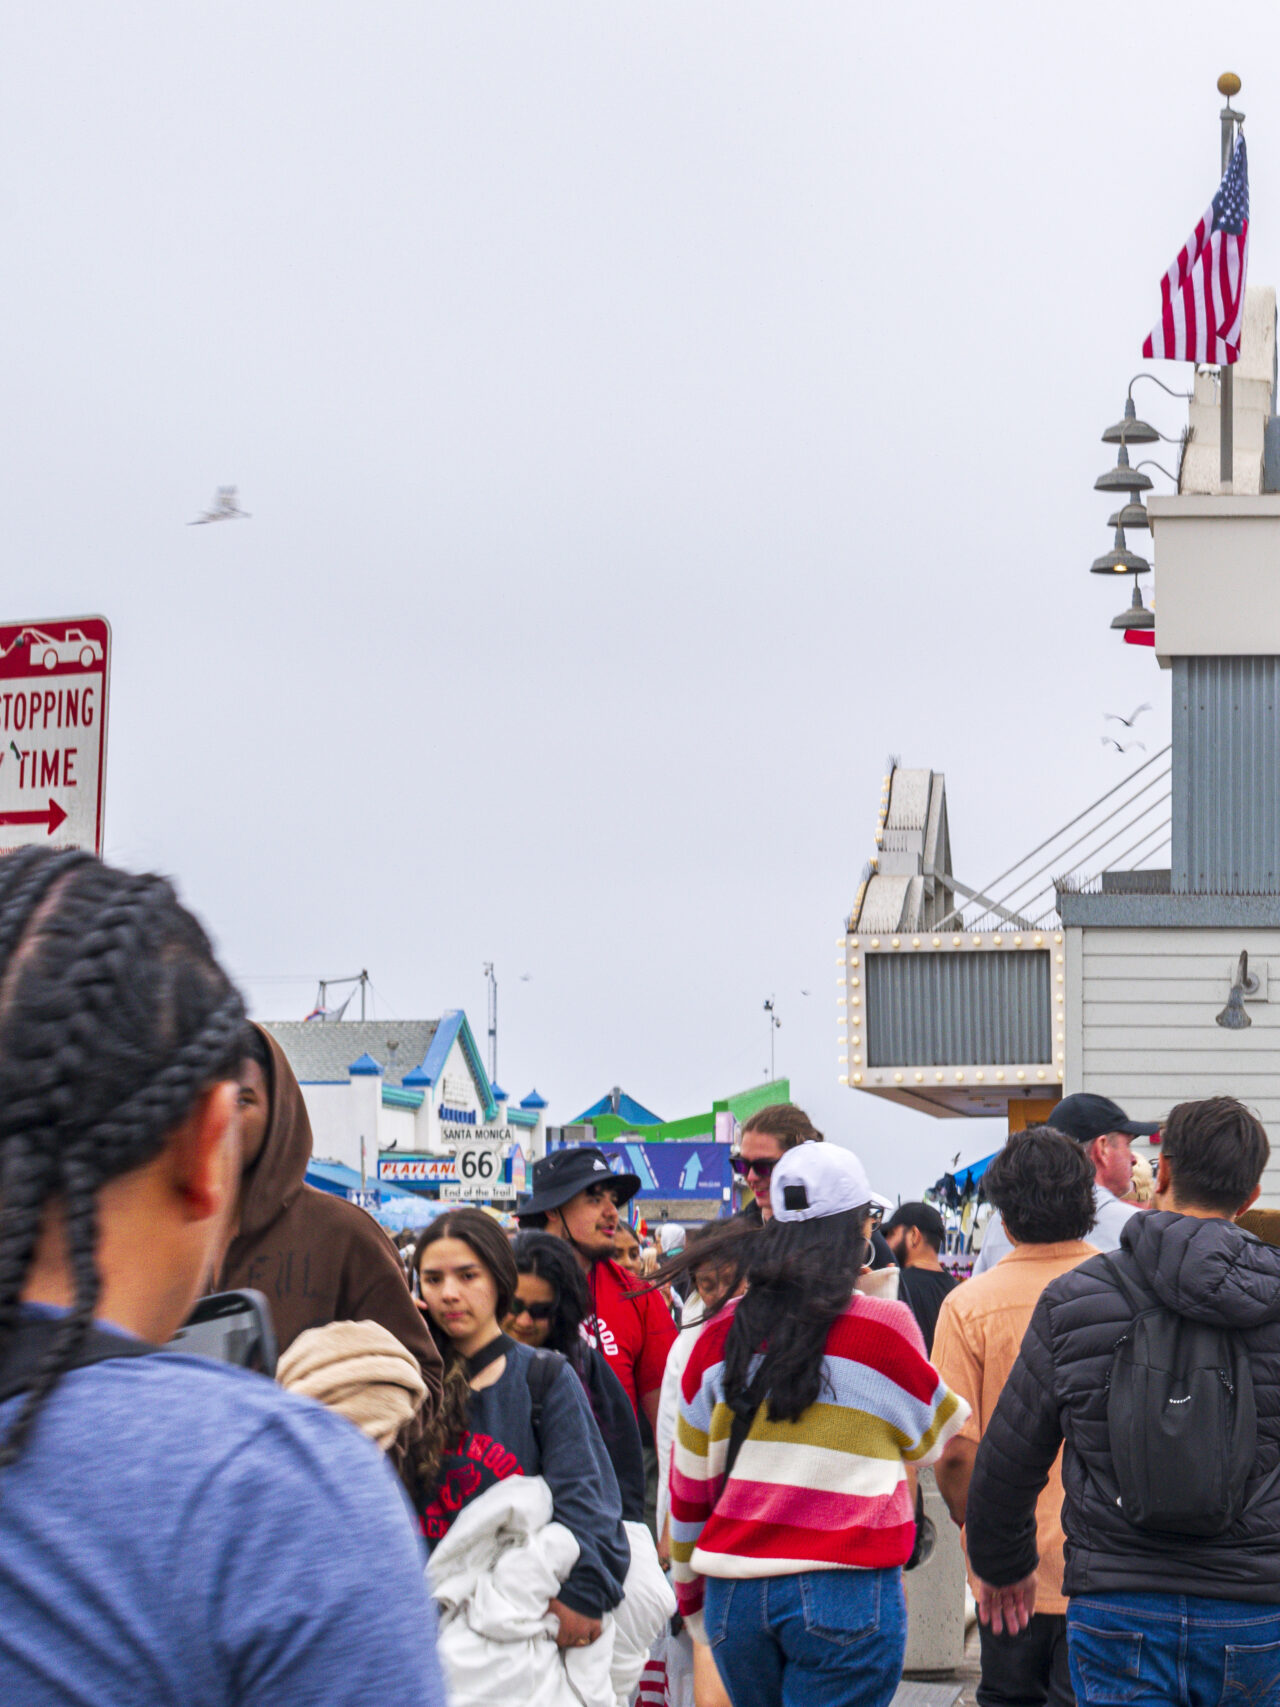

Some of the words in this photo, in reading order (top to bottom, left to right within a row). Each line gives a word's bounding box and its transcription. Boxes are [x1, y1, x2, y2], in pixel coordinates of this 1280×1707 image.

[0, 687, 94, 731] TOPPING
[18, 748, 78, 789] TIME
[443, 1129, 471, 1140] SANTA
[475, 1129, 511, 1140] MONICA
[382, 1162, 455, 1174] PLAYLAN
[462, 1151, 493, 1178] 66
[444, 1189, 460, 1198] End
[464, 1188, 473, 1198] of
[475, 1188, 489, 1198] the
[492, 1188, 511, 1198] Trail
